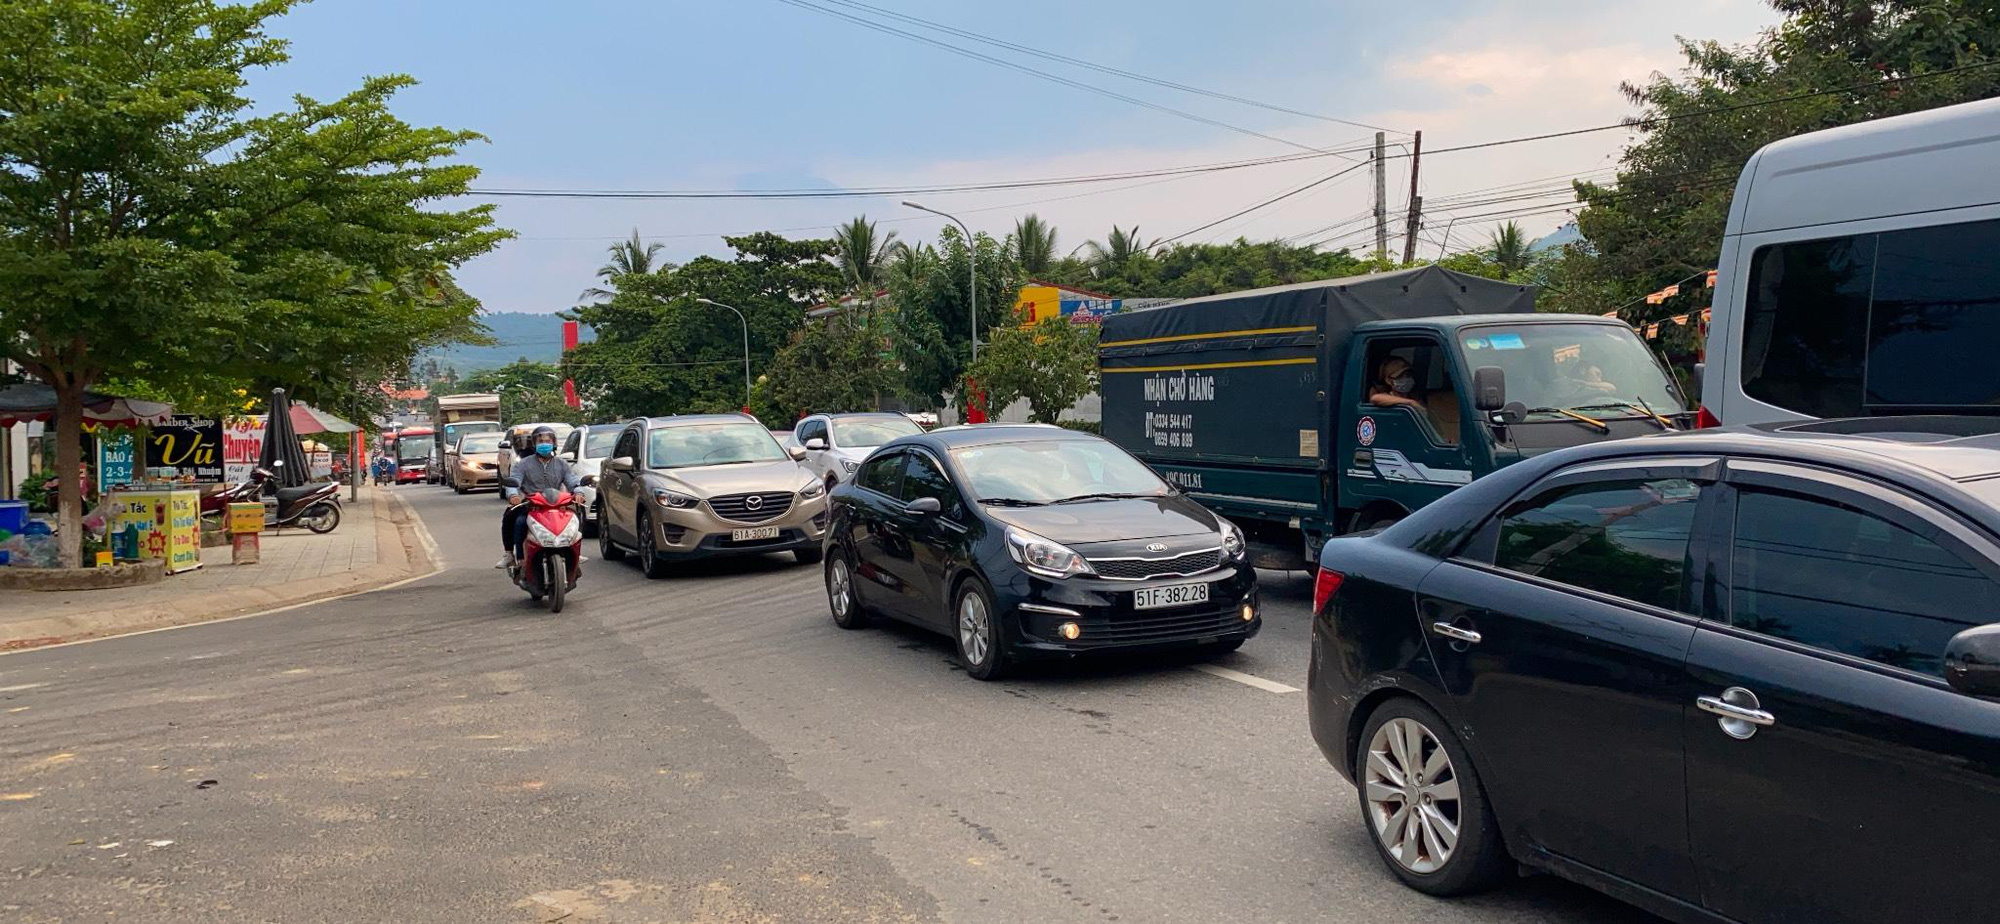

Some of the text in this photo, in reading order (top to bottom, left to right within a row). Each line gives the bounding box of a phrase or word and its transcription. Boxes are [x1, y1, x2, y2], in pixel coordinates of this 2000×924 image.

[1144, 368, 1214, 407] NHẬN CHỞ HÀNG
[1170, 413, 1180, 429] 544
[1181, 414, 1192, 430] 417
[155, 432, 215, 465] Vũ
[1137, 585, 1207, 607] 51F-382.28
